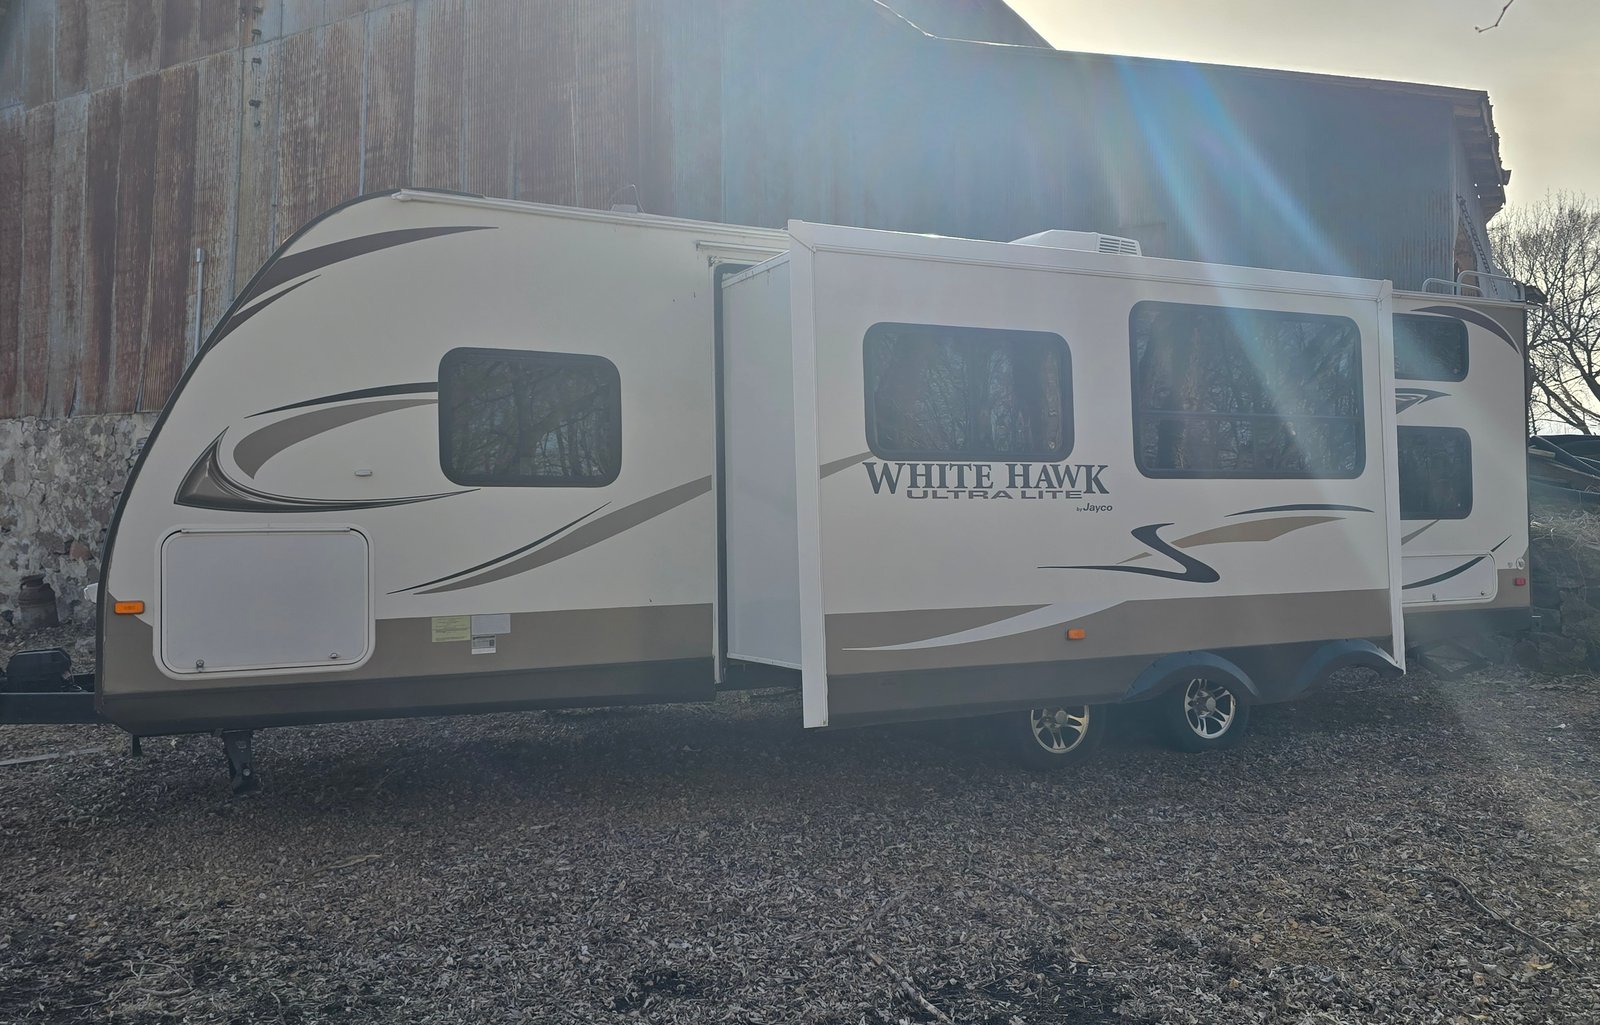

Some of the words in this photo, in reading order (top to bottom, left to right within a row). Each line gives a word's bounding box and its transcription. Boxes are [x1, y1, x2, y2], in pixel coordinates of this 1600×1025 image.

[862, 462, 994, 495] WHITE
[1005, 463, 1110, 495] HAWK
[906, 490, 1014, 500] ULTRA
[1021, 490, 1083, 499] LITE
[1083, 502, 1113, 513] Jayco
